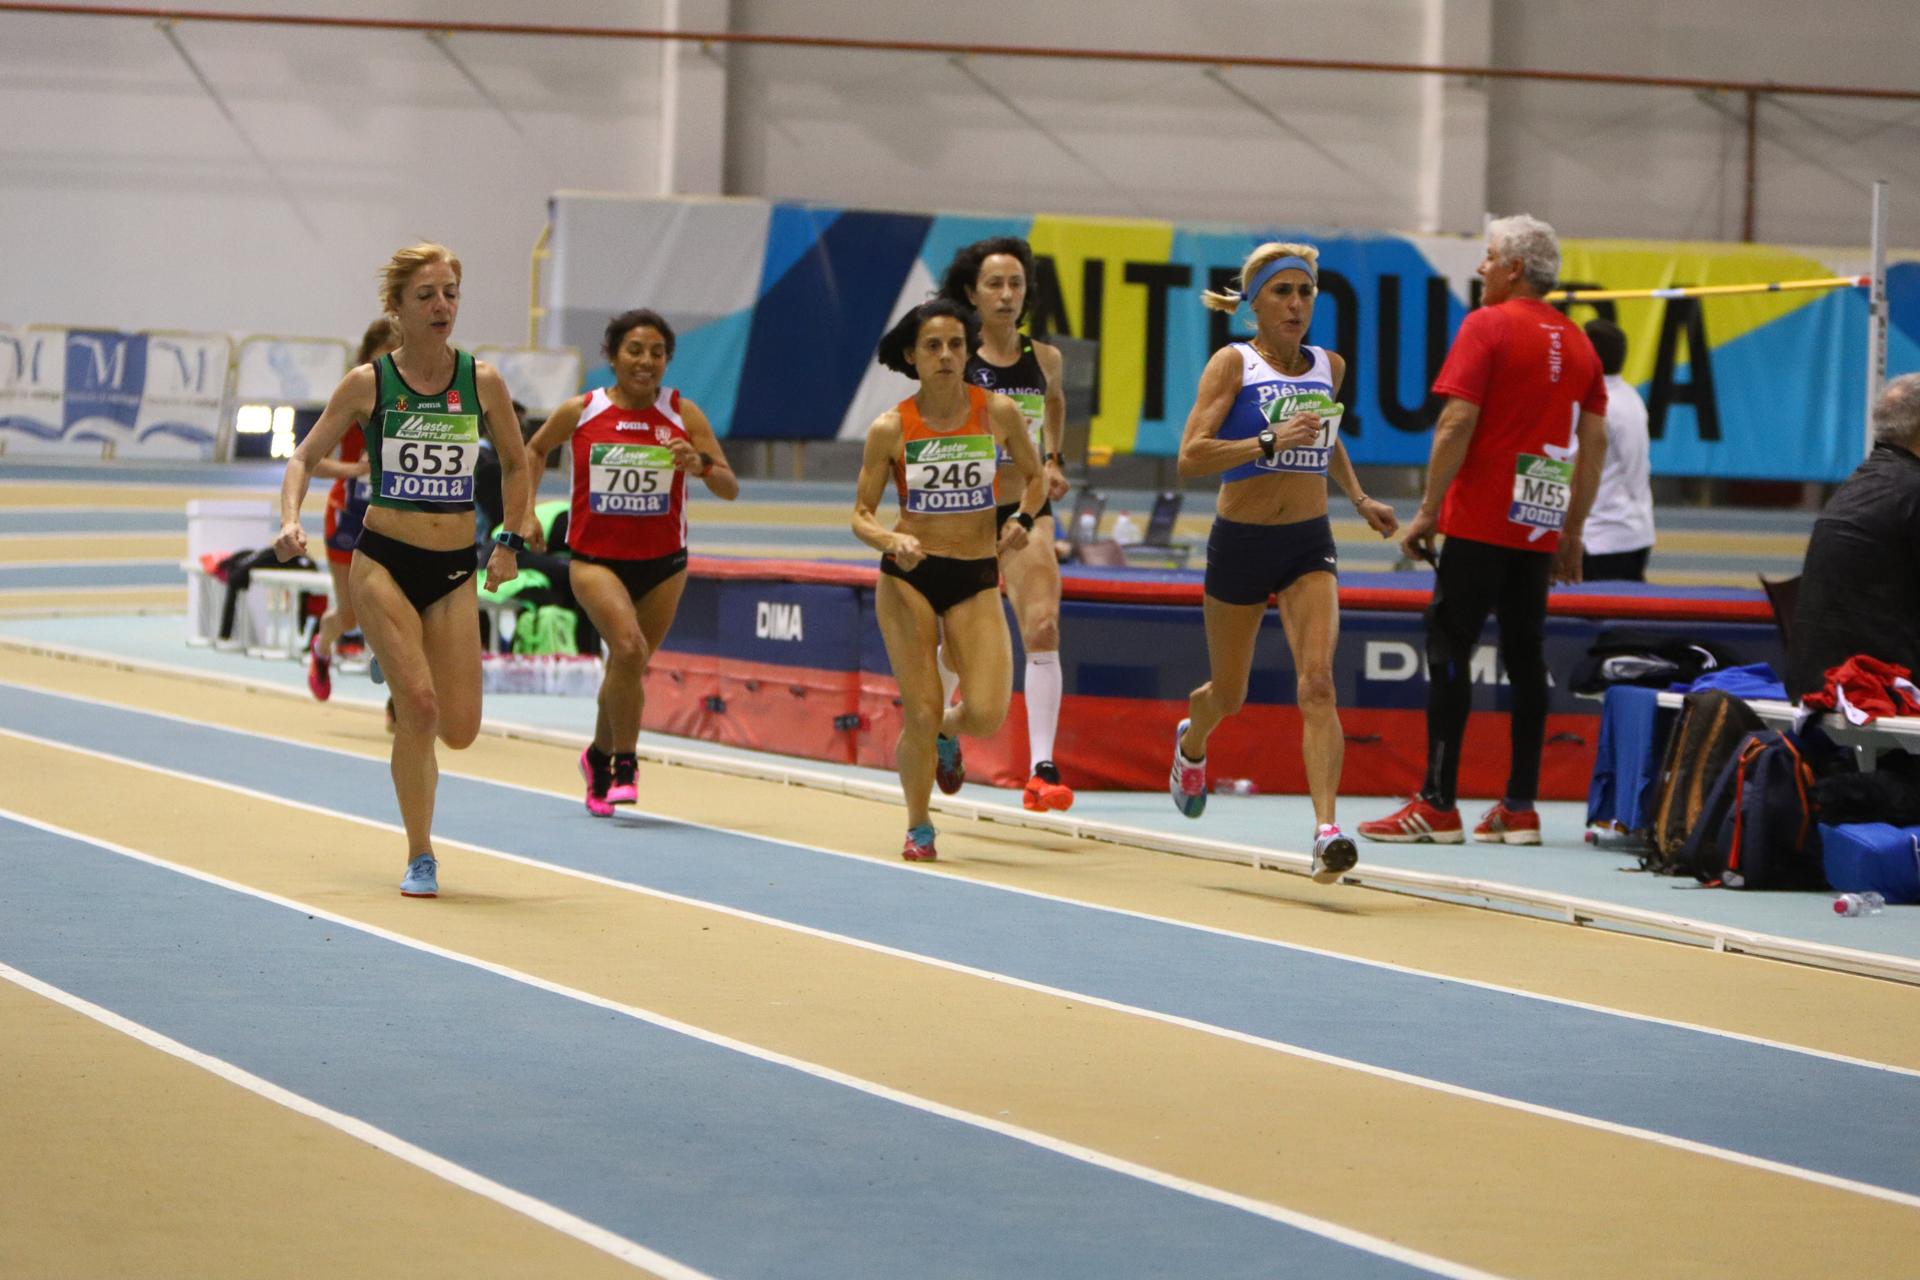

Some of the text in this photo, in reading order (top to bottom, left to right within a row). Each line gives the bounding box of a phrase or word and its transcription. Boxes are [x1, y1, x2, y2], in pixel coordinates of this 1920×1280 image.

[615, 420, 650, 431] Joma
[398, 442, 465, 476] 653
[389, 475, 465, 497] Joma
[604, 468, 658, 493] 705
[922, 461, 982, 490] 246
[596, 494, 661, 512] Joma
[915, 489, 986, 511] Joma
[1522, 478, 1565, 508] M55
[756, 601, 803, 641] DIMA
